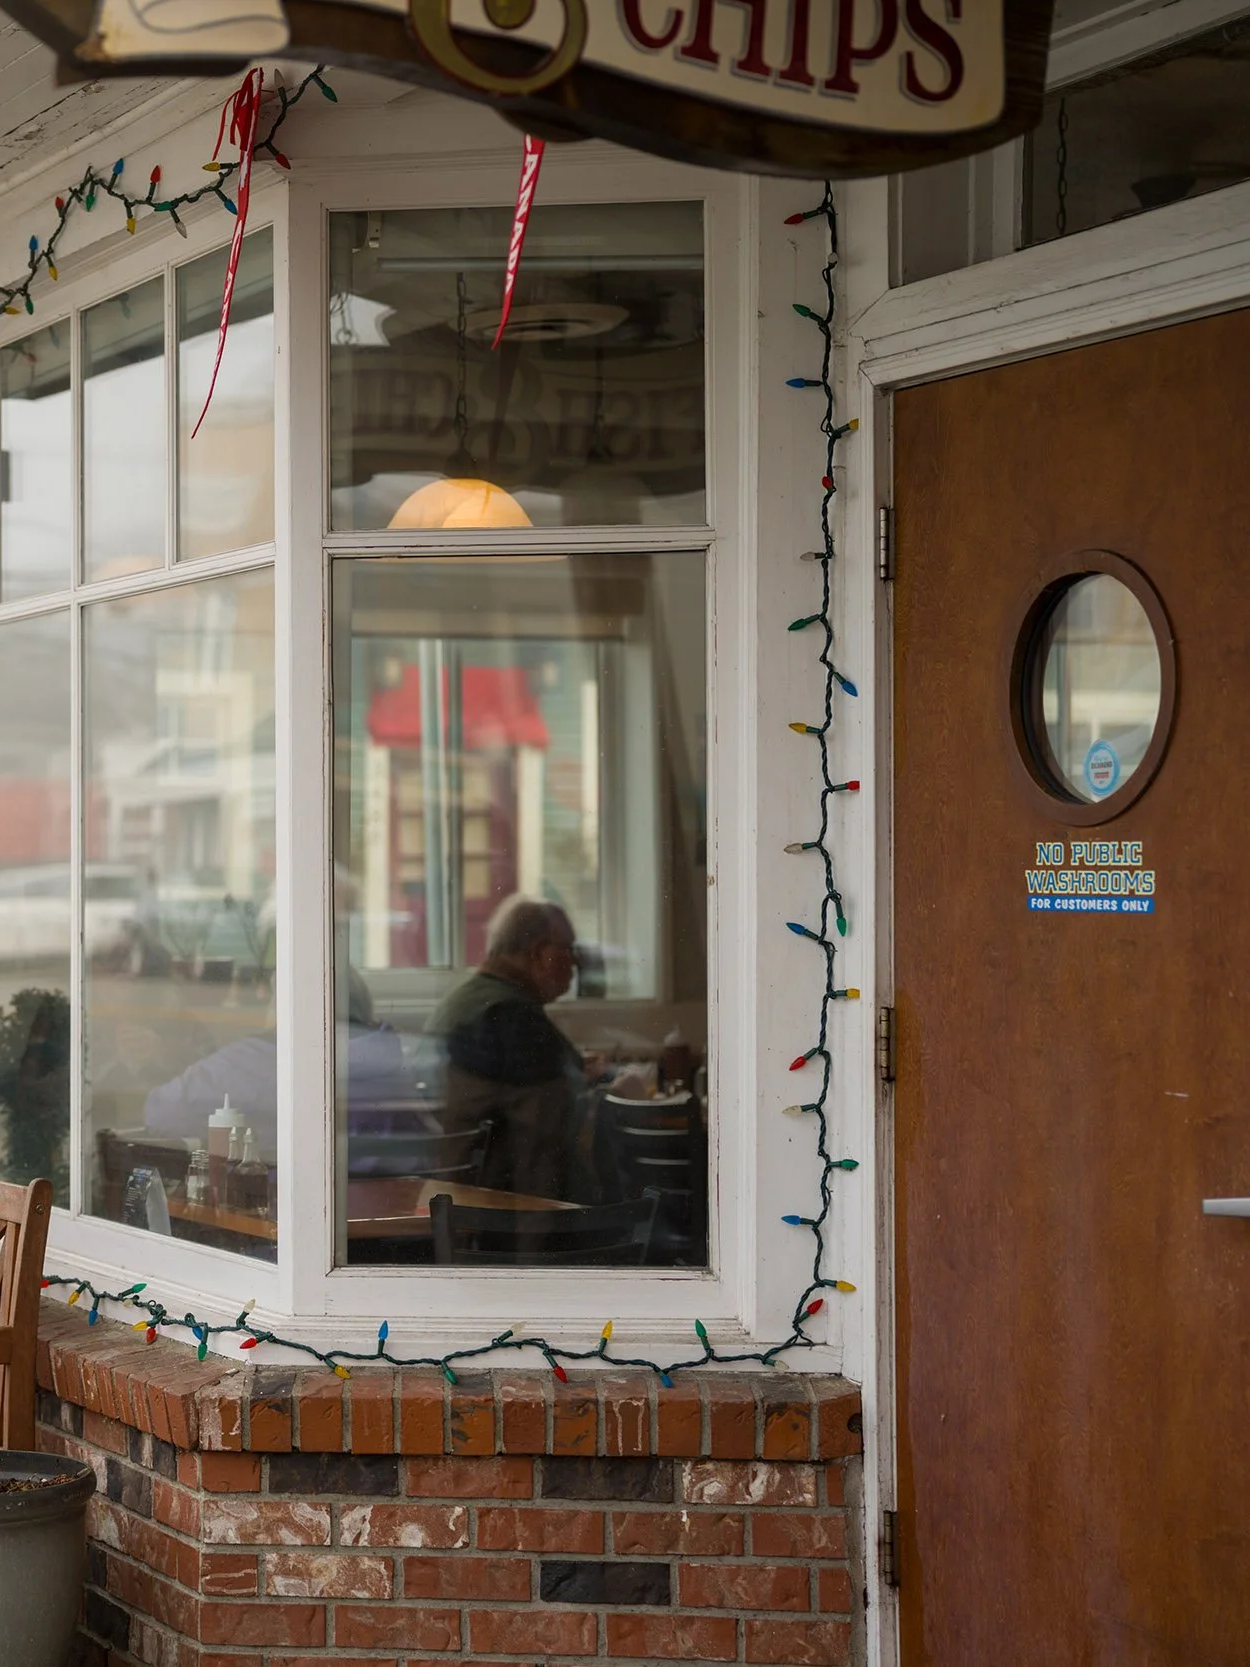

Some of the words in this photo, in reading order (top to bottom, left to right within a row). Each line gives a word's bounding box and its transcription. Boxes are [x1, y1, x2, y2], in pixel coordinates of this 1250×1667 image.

[505, 134, 540, 295] ANADA
[1036, 842, 1065, 866] NO
[1070, 841, 1143, 866] PUBLIC
[1025, 870, 1155, 895] WASHROOMS
[1031, 898, 1051, 909] FOR
[1054, 899, 1117, 911] CUSTOMERS
[1121, 900, 1150, 912] ONLY
